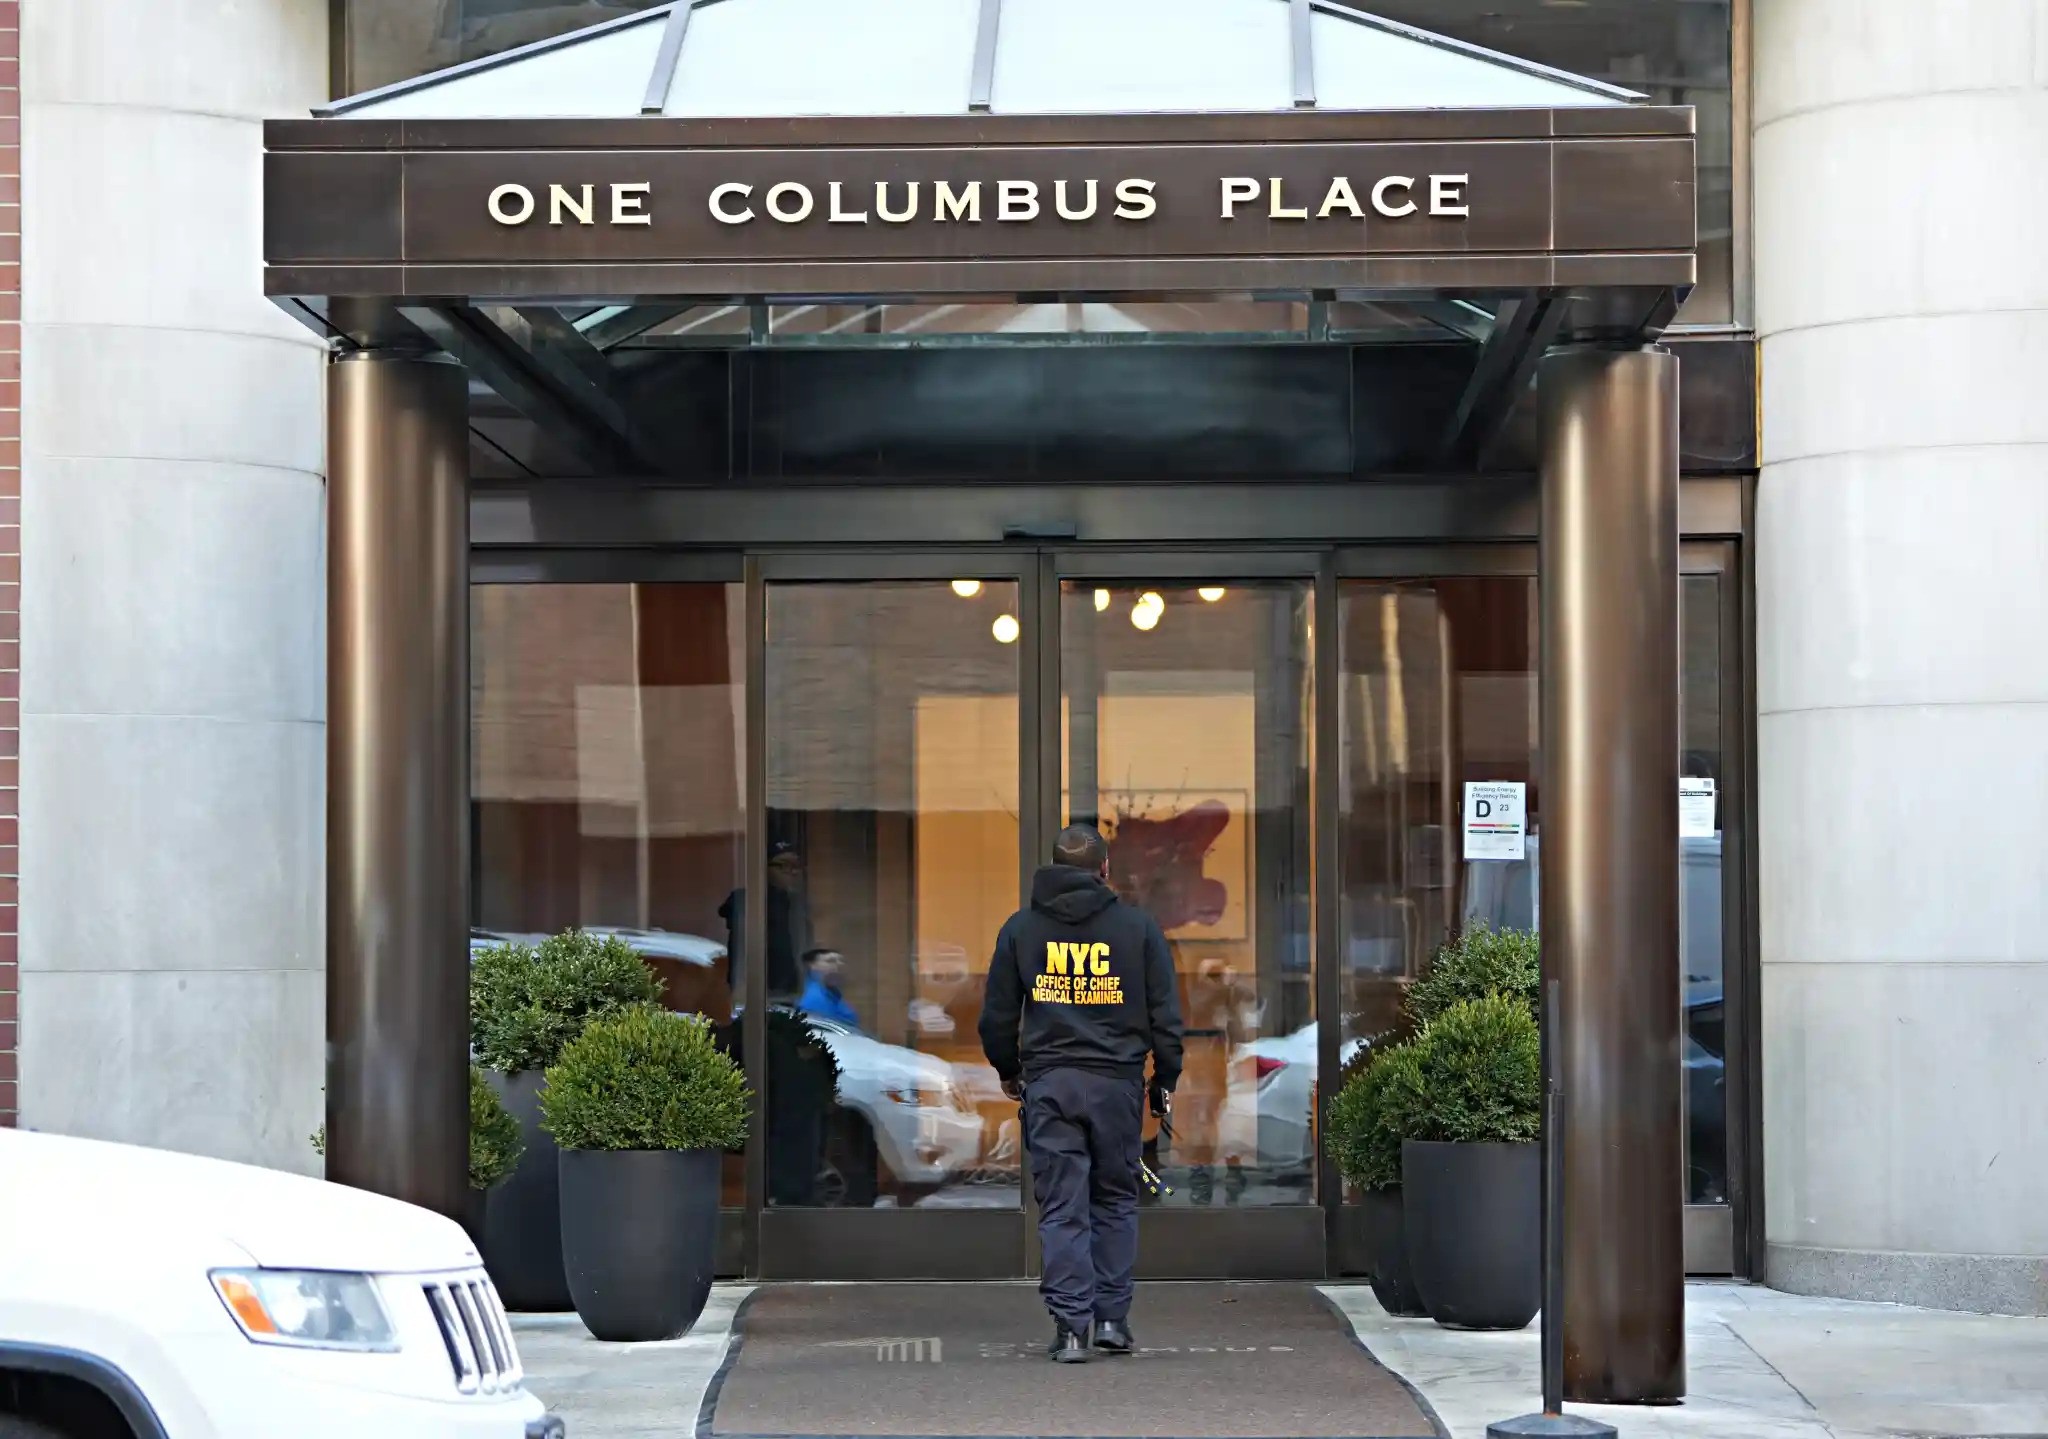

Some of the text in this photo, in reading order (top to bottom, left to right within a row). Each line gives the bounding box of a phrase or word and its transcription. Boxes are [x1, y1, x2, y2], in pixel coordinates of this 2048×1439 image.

[488, 172, 1471, 226] ONE COLUMBUS PLACE
[1476, 800, 1491, 818] D
[1046, 942, 1110, 976] NYC
[1036, 975, 1120, 991] OFFICE OF CHIEF
[1032, 988, 1124, 1004] MEDICAL EXAMINER
